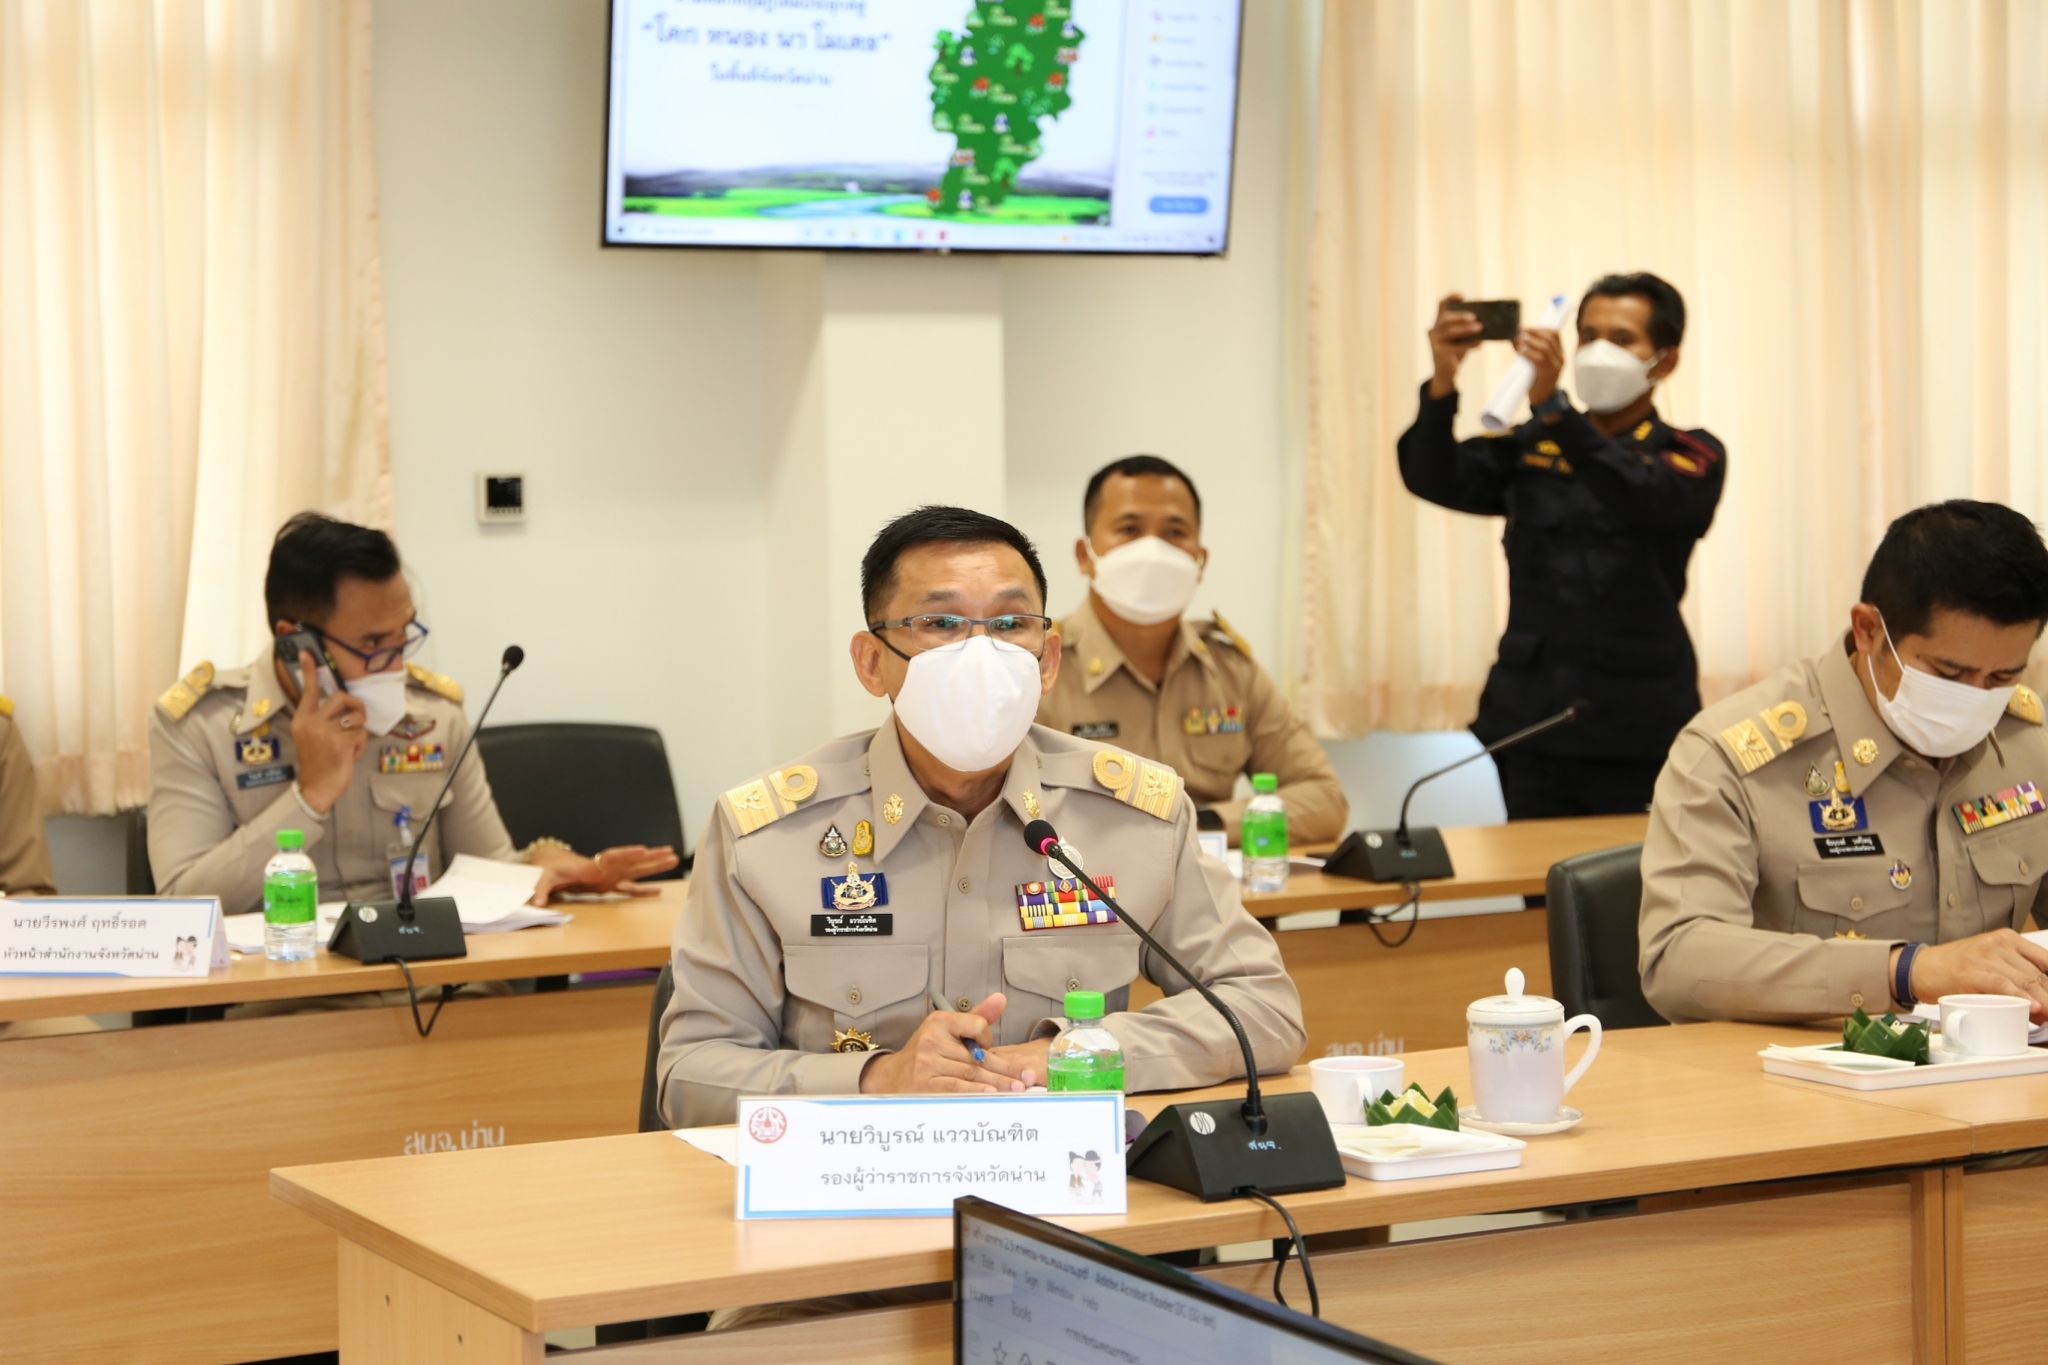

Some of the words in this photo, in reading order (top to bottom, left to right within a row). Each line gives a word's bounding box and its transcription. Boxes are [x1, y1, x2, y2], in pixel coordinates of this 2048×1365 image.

[13, 914, 89, 930] นายวีรพงศ์
[3, 946, 160, 960] หัวหน้าสำนักงานจังหวัดน่าน
[819, 1122, 926, 1152] นายวิบูรณ์
[933, 1121, 1039, 1144] แววบัณฑิต
[820, 1164, 1047, 1192] รองผู้ว่าราชการจังหวัดน่าน
[1002, 1262, 1018, 1279] View
[1047, 1280, 1075, 1301] Window
[1096, 1271, 1119, 1292] Adobe
[1120, 1281, 1148, 1304] Acrobat
[970, 1285, 995, 1308] Home
[1010, 1299, 1033, 1323] Tools
